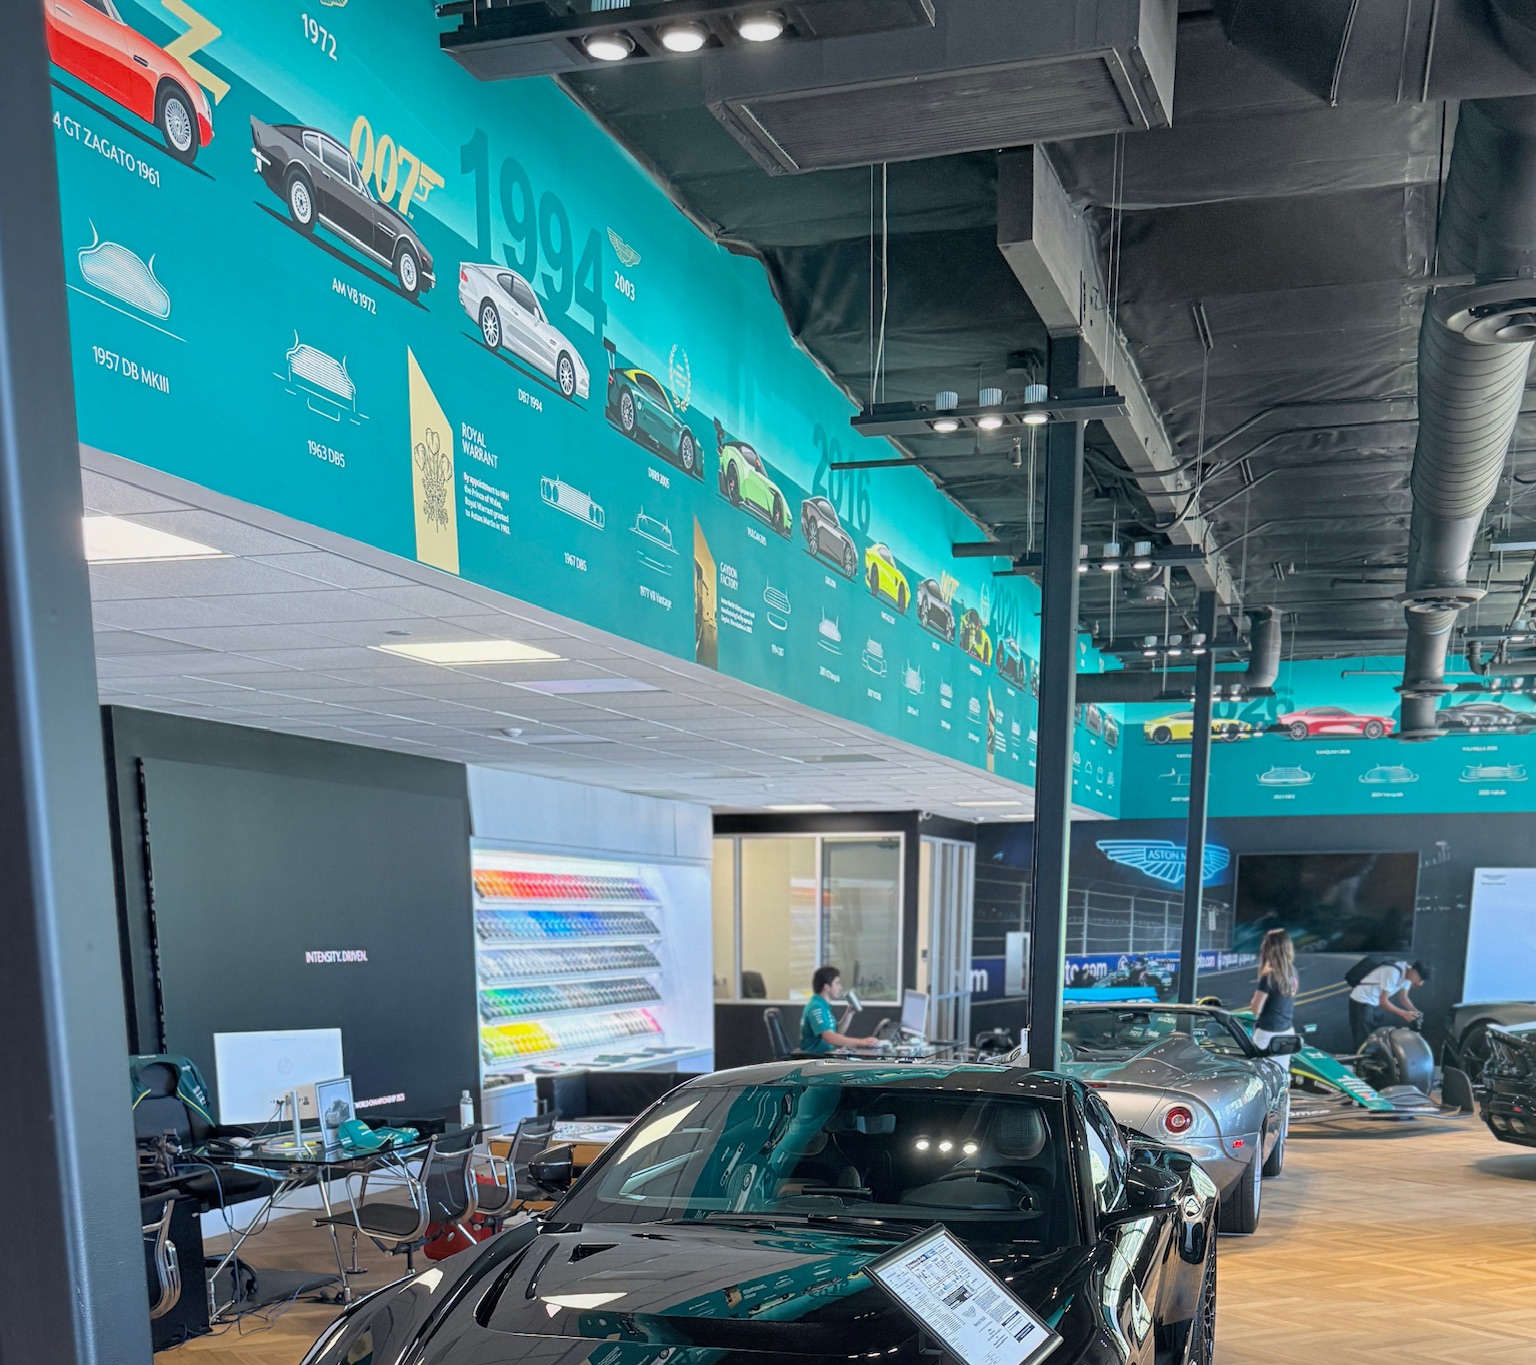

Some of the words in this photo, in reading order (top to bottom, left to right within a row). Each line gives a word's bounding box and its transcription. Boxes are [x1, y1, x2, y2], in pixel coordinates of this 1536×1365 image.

[301, 13, 338, 61] 1972
[63, 116, 80, 140] GT
[83, 128, 136, 172] ZAGATO
[136, 160, 161, 188] 1961
[350, 115, 421, 216] 007
[460, 127, 608, 343] 1994
[332, 277, 347, 297] AM
[346, 284, 359, 305] V8
[359, 292, 377, 315] 1972
[614, 270, 636, 302] 2003
[92, 345, 120, 373] 1957
[121, 357, 140, 381] DB
[141, 366, 170, 395] MKIII
[307, 439, 328, 461] 1963
[328, 447, 346, 468] DB5
[461, 421, 487, 449] ROYAL
[462, 438, 498, 469] WARRANT
[1147, 849, 1180, 861] ASTON
